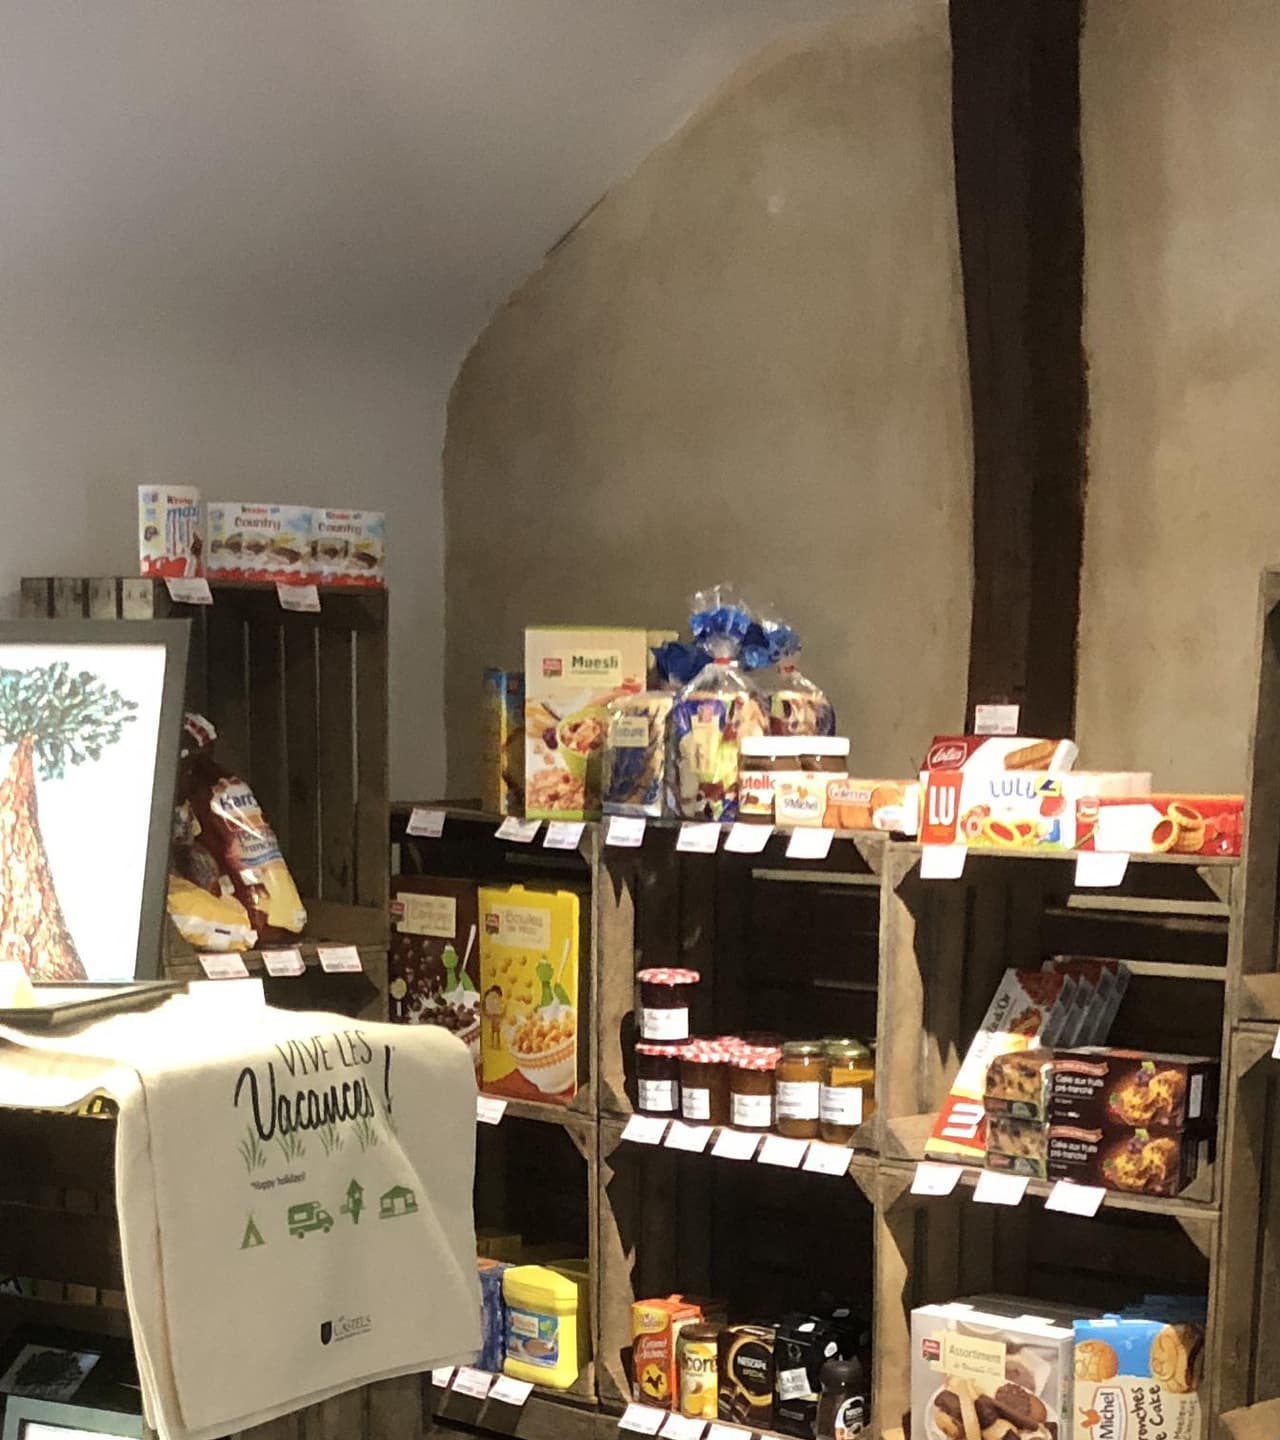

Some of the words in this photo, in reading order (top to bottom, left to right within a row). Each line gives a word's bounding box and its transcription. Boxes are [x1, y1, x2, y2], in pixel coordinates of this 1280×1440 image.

[234, 517, 281, 532] Country
[571, 655, 619, 669] Muesli
[739, 774, 776, 790] utell
[989, 778, 1038, 800] LULU
[927, 784, 957, 826] LU
[275, 1034, 333, 1077] VIVE
[333, 1029, 373, 1067] LES
[234, 1061, 376, 1142] Vacances
[941, 1102, 986, 1139] LU
[1148, 1384, 1164, 1428] Cake
